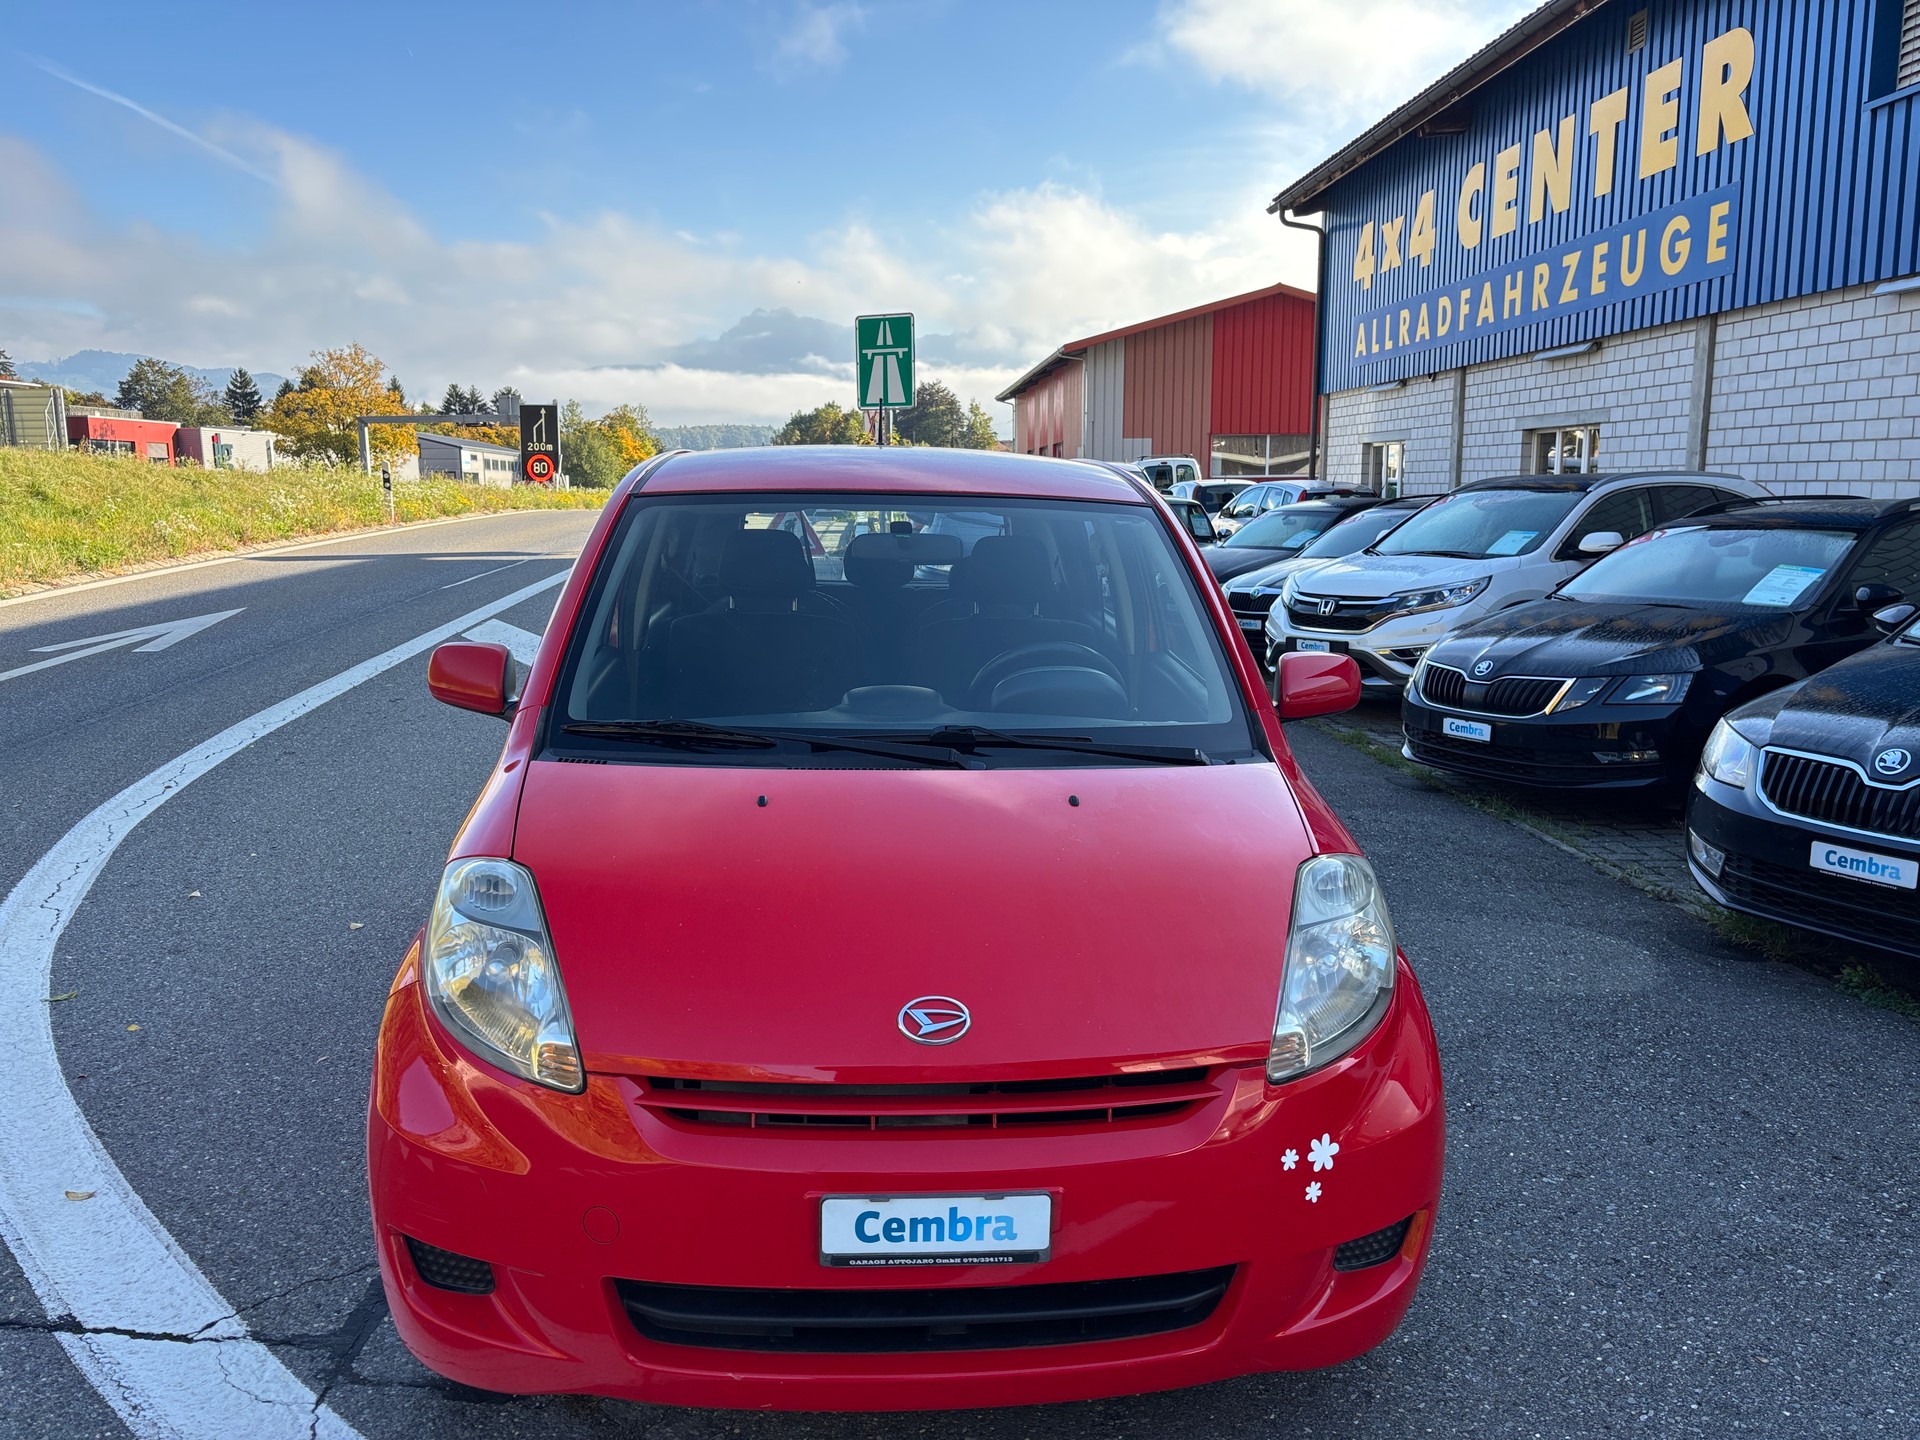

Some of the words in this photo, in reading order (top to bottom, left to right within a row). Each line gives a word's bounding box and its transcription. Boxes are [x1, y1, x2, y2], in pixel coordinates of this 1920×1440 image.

[1353, 188, 1436, 291] 4x4
[1457, 26, 1755, 250] CENTER
[1354, 200, 1731, 359] ALLRADFAHRZEUGE
[527, 442, 553, 451] 200m
[533, 462, 548, 474] 80
[1300, 641, 1325, 652] Cembra
[1449, 722, 1484, 736] Cembra
[1824, 849, 1901, 881] Cembra
[855, 1206, 1017, 1243] Cembra
